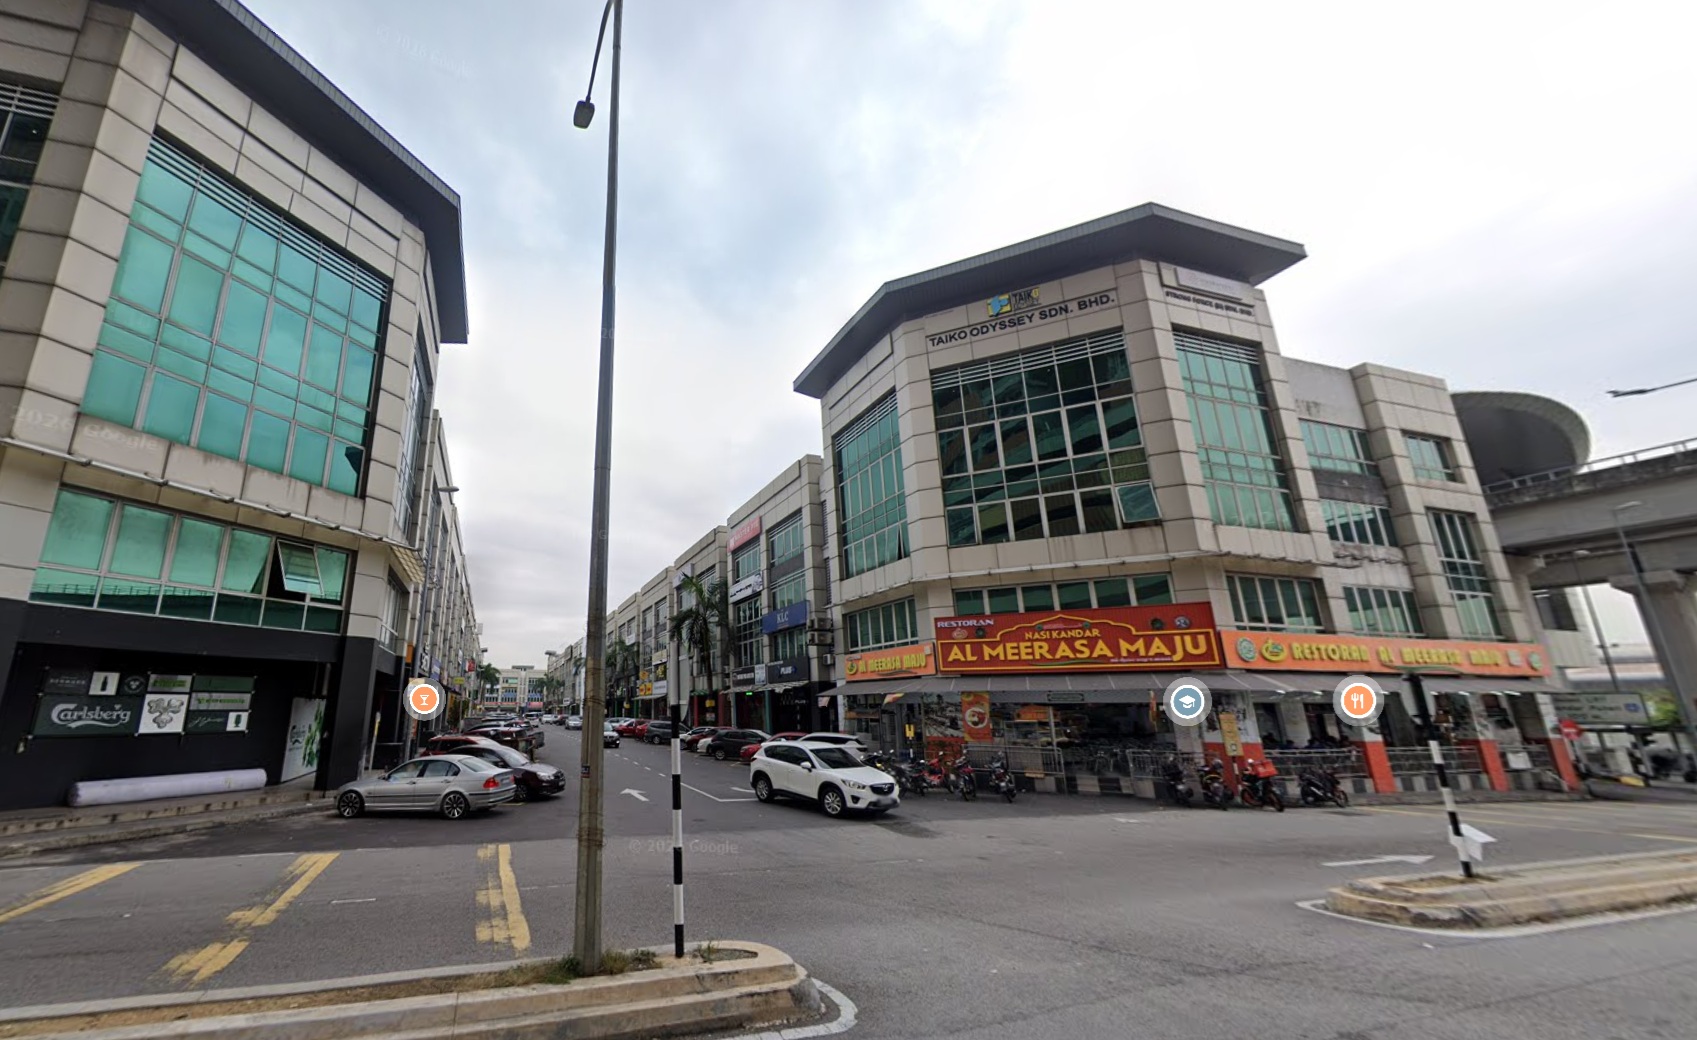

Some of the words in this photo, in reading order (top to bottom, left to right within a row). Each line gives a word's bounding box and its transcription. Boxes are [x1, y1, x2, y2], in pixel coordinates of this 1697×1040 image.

[1011, 287, 1040, 303] TAIKO
[929, 330, 968, 348] TAIKO
[969, 313, 1035, 338] ODYSSEY
[1039, 304, 1073, 321] SDN.
[1077, 293, 1116, 311] BHD.
[776, 610, 789, 623] KLC
[937, 618, 994, 628] RESTORAN
[1025, 631, 1051, 640] NASI
[1052, 628, 1101, 639] KANDAR
[947, 644, 978, 662] AL
[983, 638, 1114, 661] MEERASA
[1118, 634, 1208, 661] MAJU
[1291, 642, 1370, 662] RESTORAN
[51, 703, 132, 728] Carlsberg
